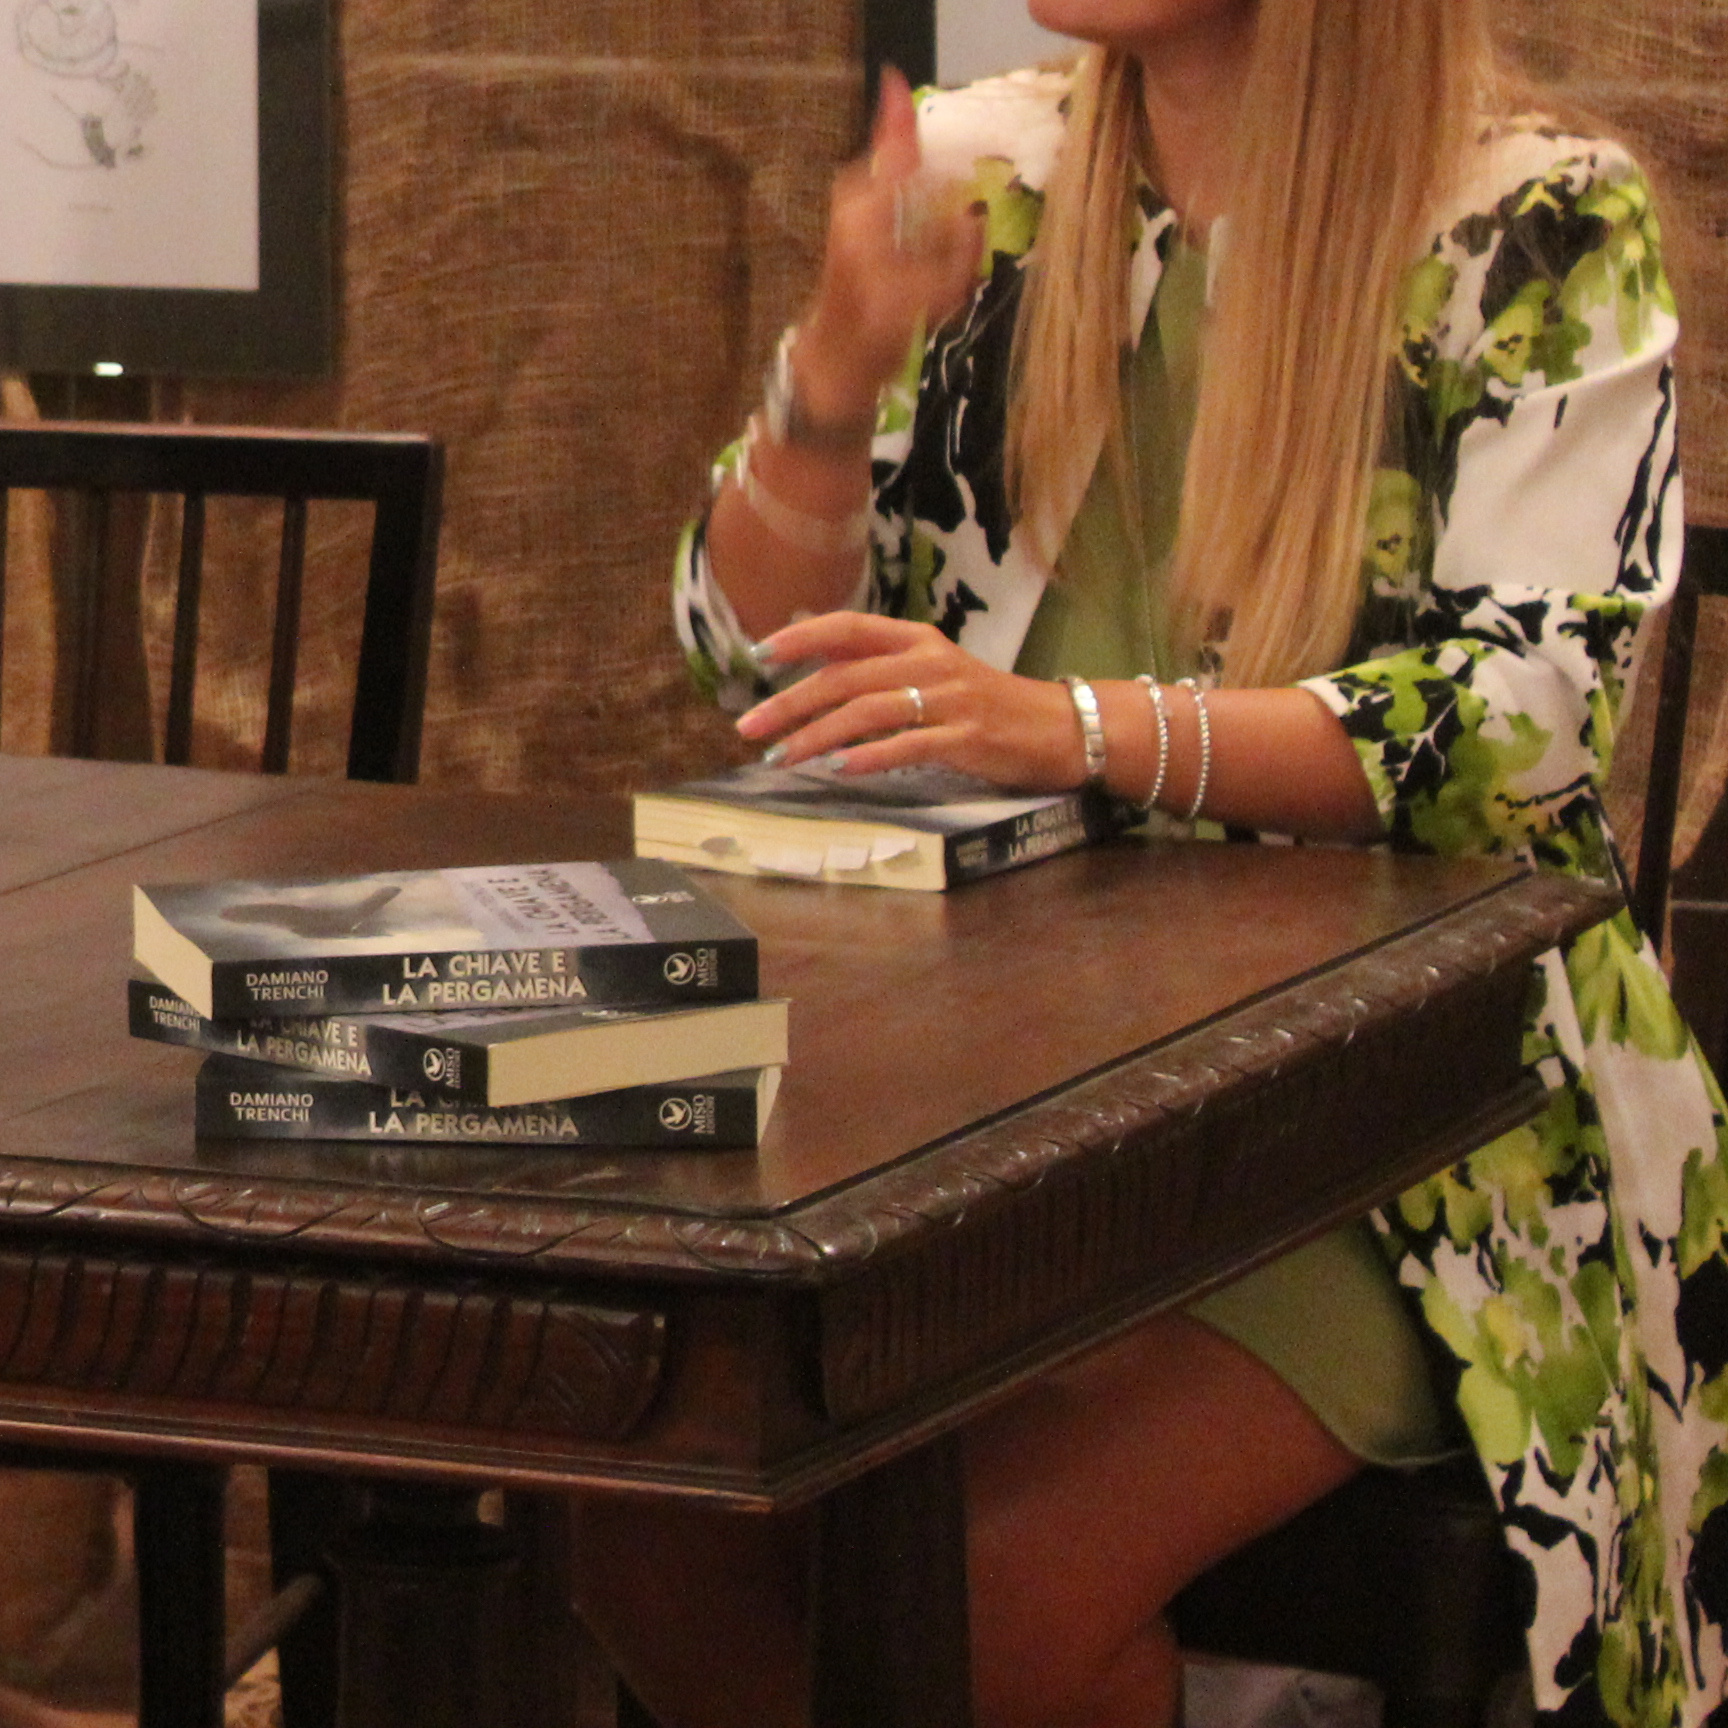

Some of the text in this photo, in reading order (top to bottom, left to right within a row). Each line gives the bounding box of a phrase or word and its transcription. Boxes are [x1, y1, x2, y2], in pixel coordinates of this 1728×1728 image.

[403, 950, 565, 979] LA CHIAVE E
[696, 947, 709, 987] MISO
[246, 969, 329, 988] DAMIANO
[250, 985, 325, 1002] TRENCHI
[382, 975, 588, 1006] LA PERGAMENA
[149, 995, 199, 1016] DAMIAN
[153, 1010, 201, 1032] TRENCHI
[347, 1025, 358, 1048] E
[237, 1029, 373, 1076] LA PERGAMENA
[230, 1091, 314, 1108] DAMIANO
[234, 1106, 310, 1122] TRENCHI
[369, 1111, 580, 1138] LA PERGAMENA
[693, 1093, 706, 1134] MISO
